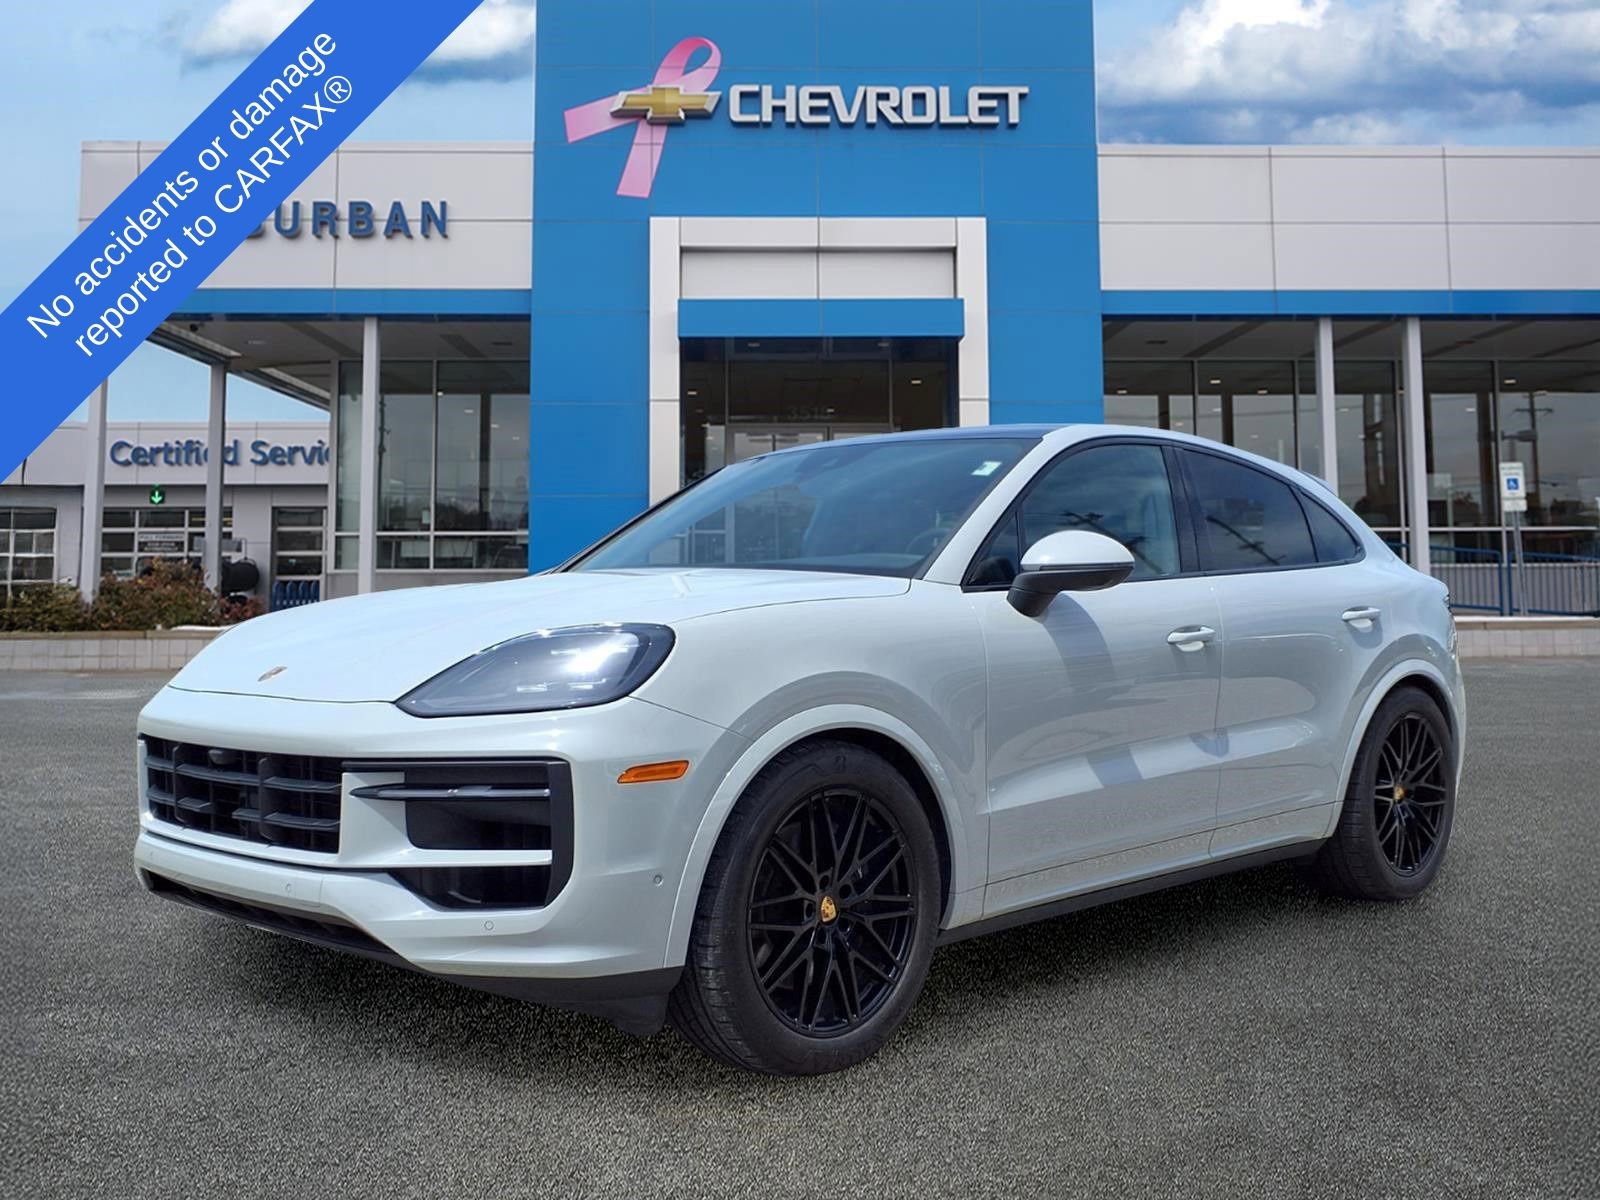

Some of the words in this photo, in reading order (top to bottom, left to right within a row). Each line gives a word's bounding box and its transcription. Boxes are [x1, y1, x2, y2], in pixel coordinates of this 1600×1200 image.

[729, 84, 1030, 126] CHEVROLET
[247, 201, 448, 239] URBAN
[110, 439, 240, 466] Certifid
